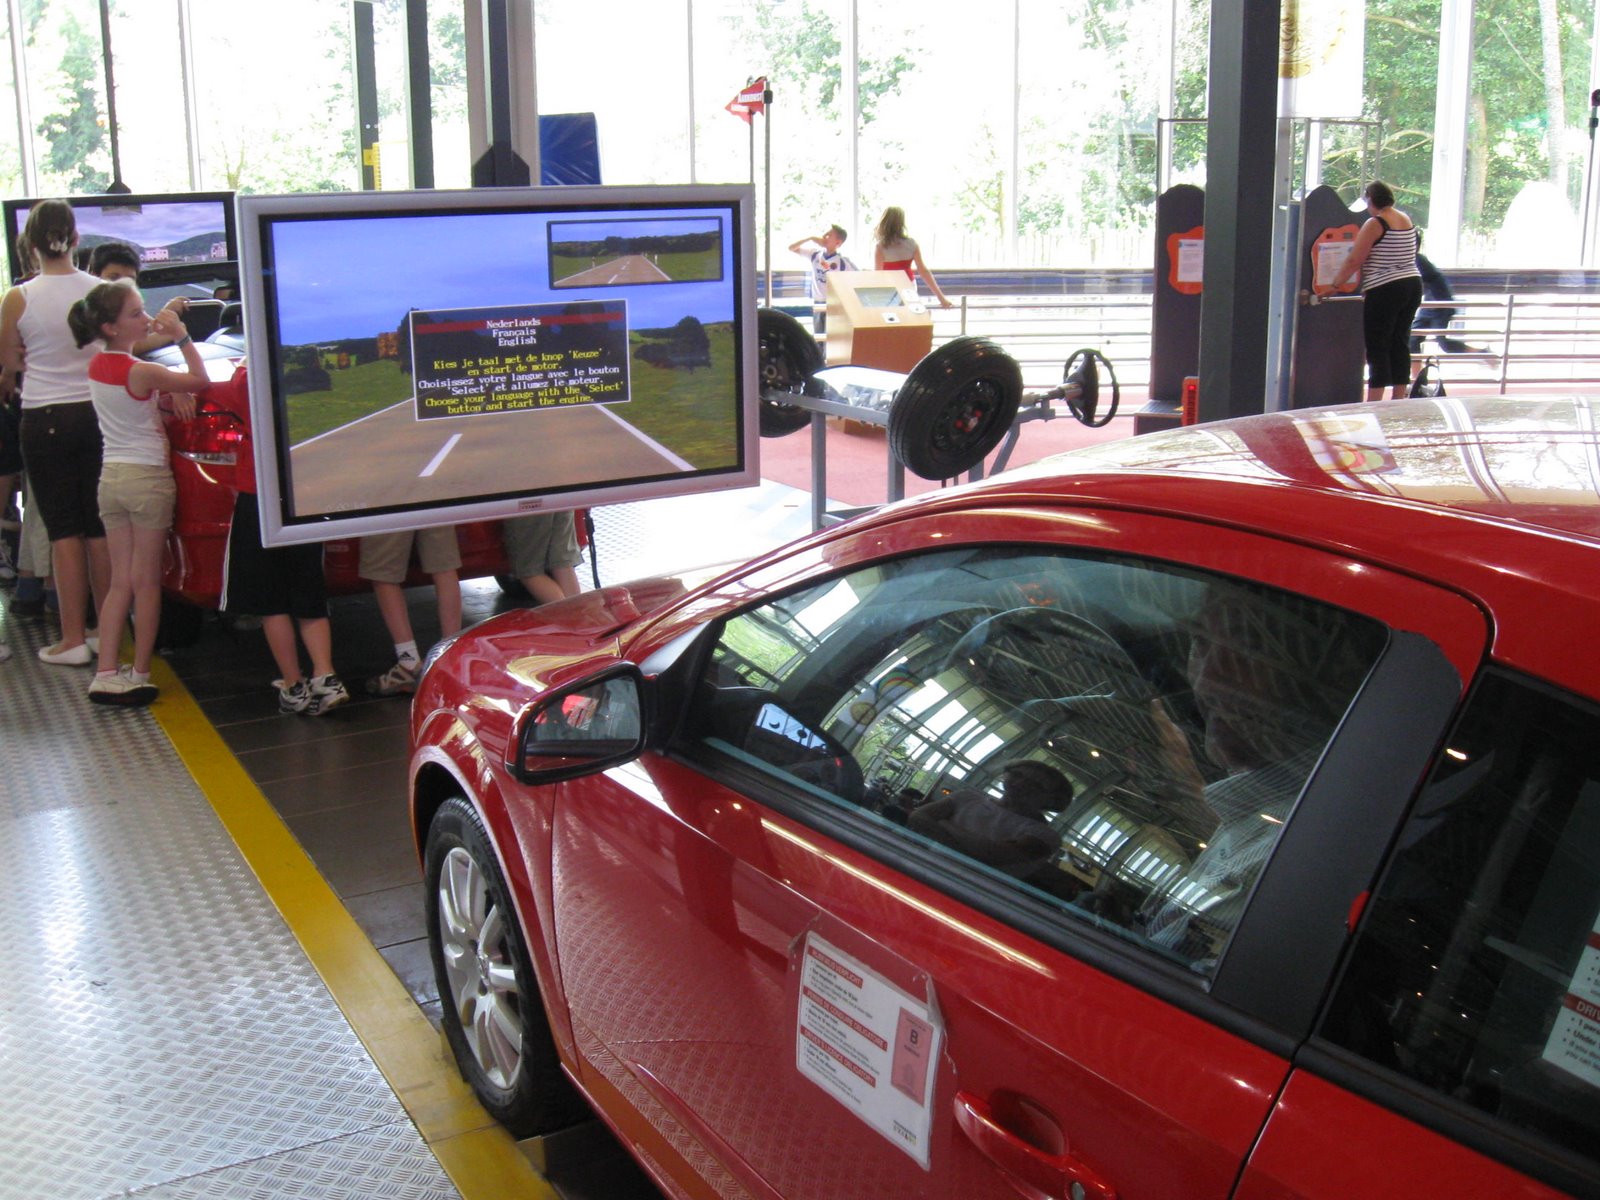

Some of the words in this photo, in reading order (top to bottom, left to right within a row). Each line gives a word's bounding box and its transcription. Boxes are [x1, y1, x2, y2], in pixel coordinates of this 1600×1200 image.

[487, 318, 541, 329] Nederlands
[499, 336, 537, 347] English
[434, 360, 457, 370] Kies
[462, 358, 474, 369] je
[479, 356, 499, 366] taal
[505, 355, 521, 364] met
[526, 353, 537, 363] de
[542, 351, 563, 362] knop
[484, 366, 511, 375] start
[516, 364, 527, 372] de
[532, 362, 562, 371] motor.
[419, 378, 474, 389] Choisissez
[479, 375, 507, 385] votre
[512, 371, 543, 382] langue
[548, 369, 569, 378] avec
[574, 367, 585, 376] le
[589, 365, 620, 375] bouton
[495, 382, 507, 392] et
[511, 380, 549, 390] allumez
[554, 378, 565, 387] le
[568, 376, 603, 387] moteur.
[425, 397, 459, 407] Choose
[464, 395, 486, 405] your
[492, 391, 534, 402] language
[538, 388, 560, 398] with
[565, 386, 580, 395] the
[448, 403, 481, 415] button
[486, 401, 502, 411] and
[506, 399, 534, 409] start
[540, 396, 555, 406] the
[910, 1029, 918, 1044] B
[1573, 1030, 1597, 1046] Under
